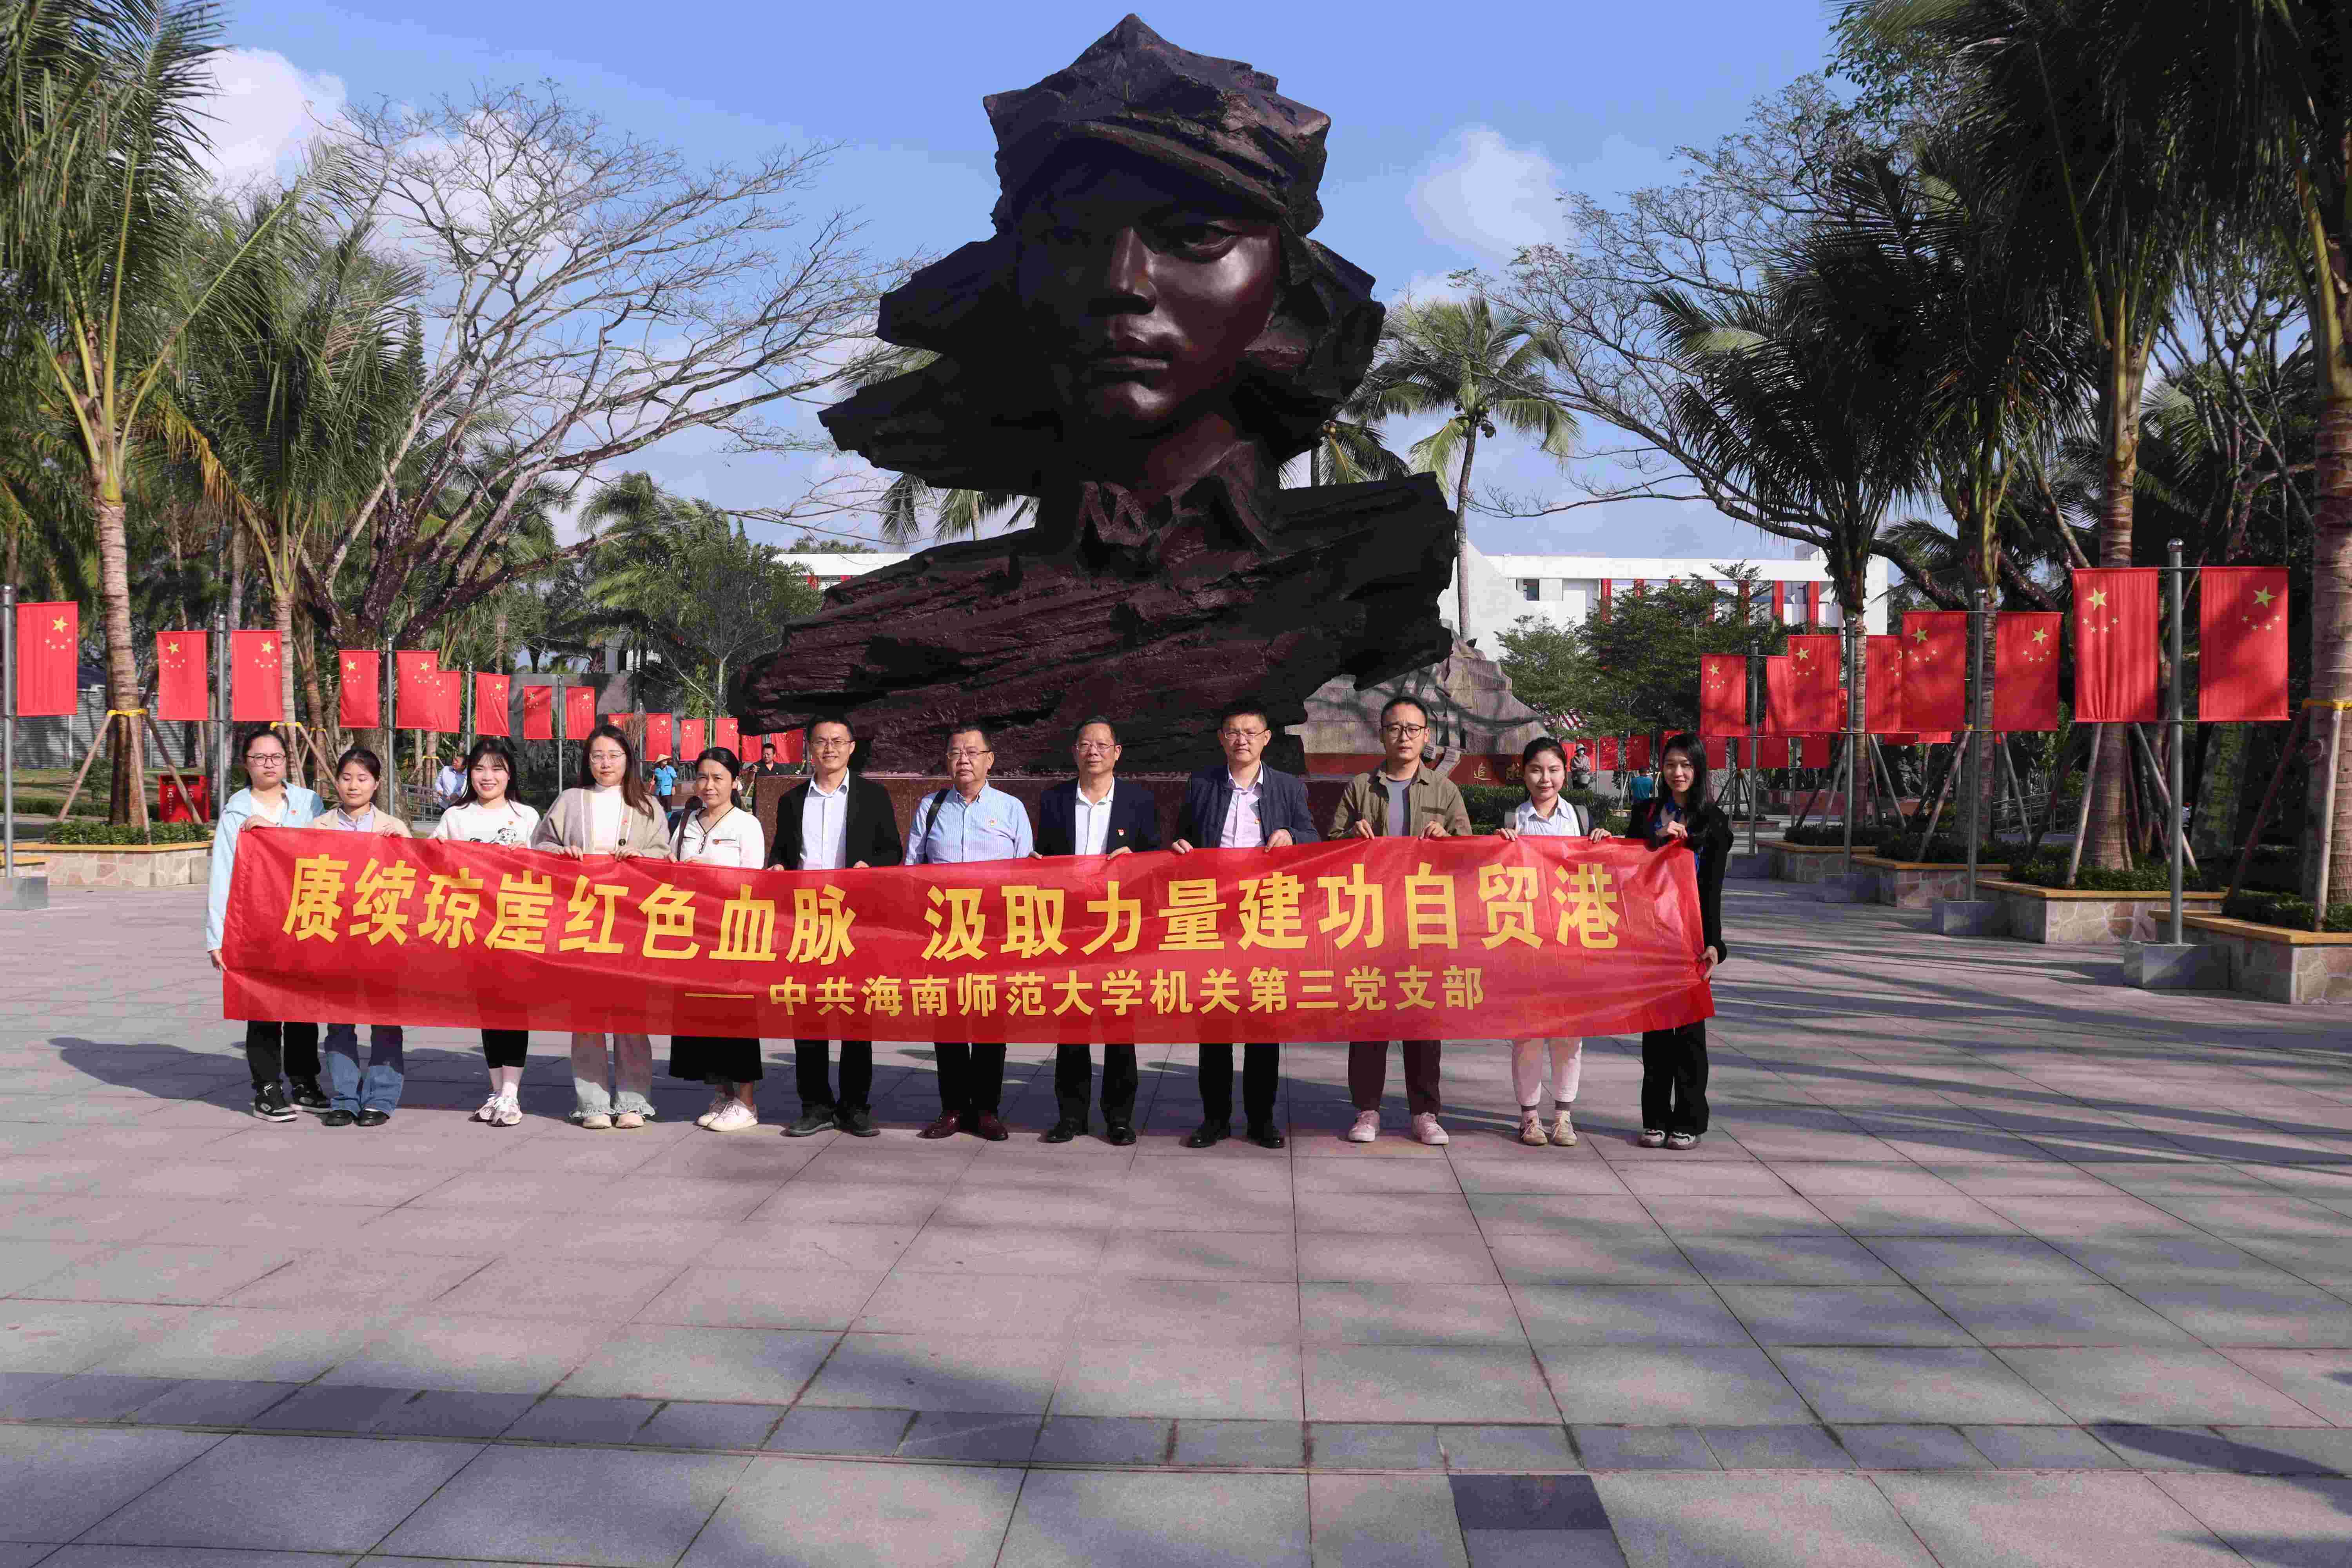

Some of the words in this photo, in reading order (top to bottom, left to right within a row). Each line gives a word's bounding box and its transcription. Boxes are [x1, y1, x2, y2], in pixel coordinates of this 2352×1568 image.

[282, 853, 856, 965] 赓续琼崖红色血脉
[920, 862, 1621, 962] 汲取力量建功自贸港
